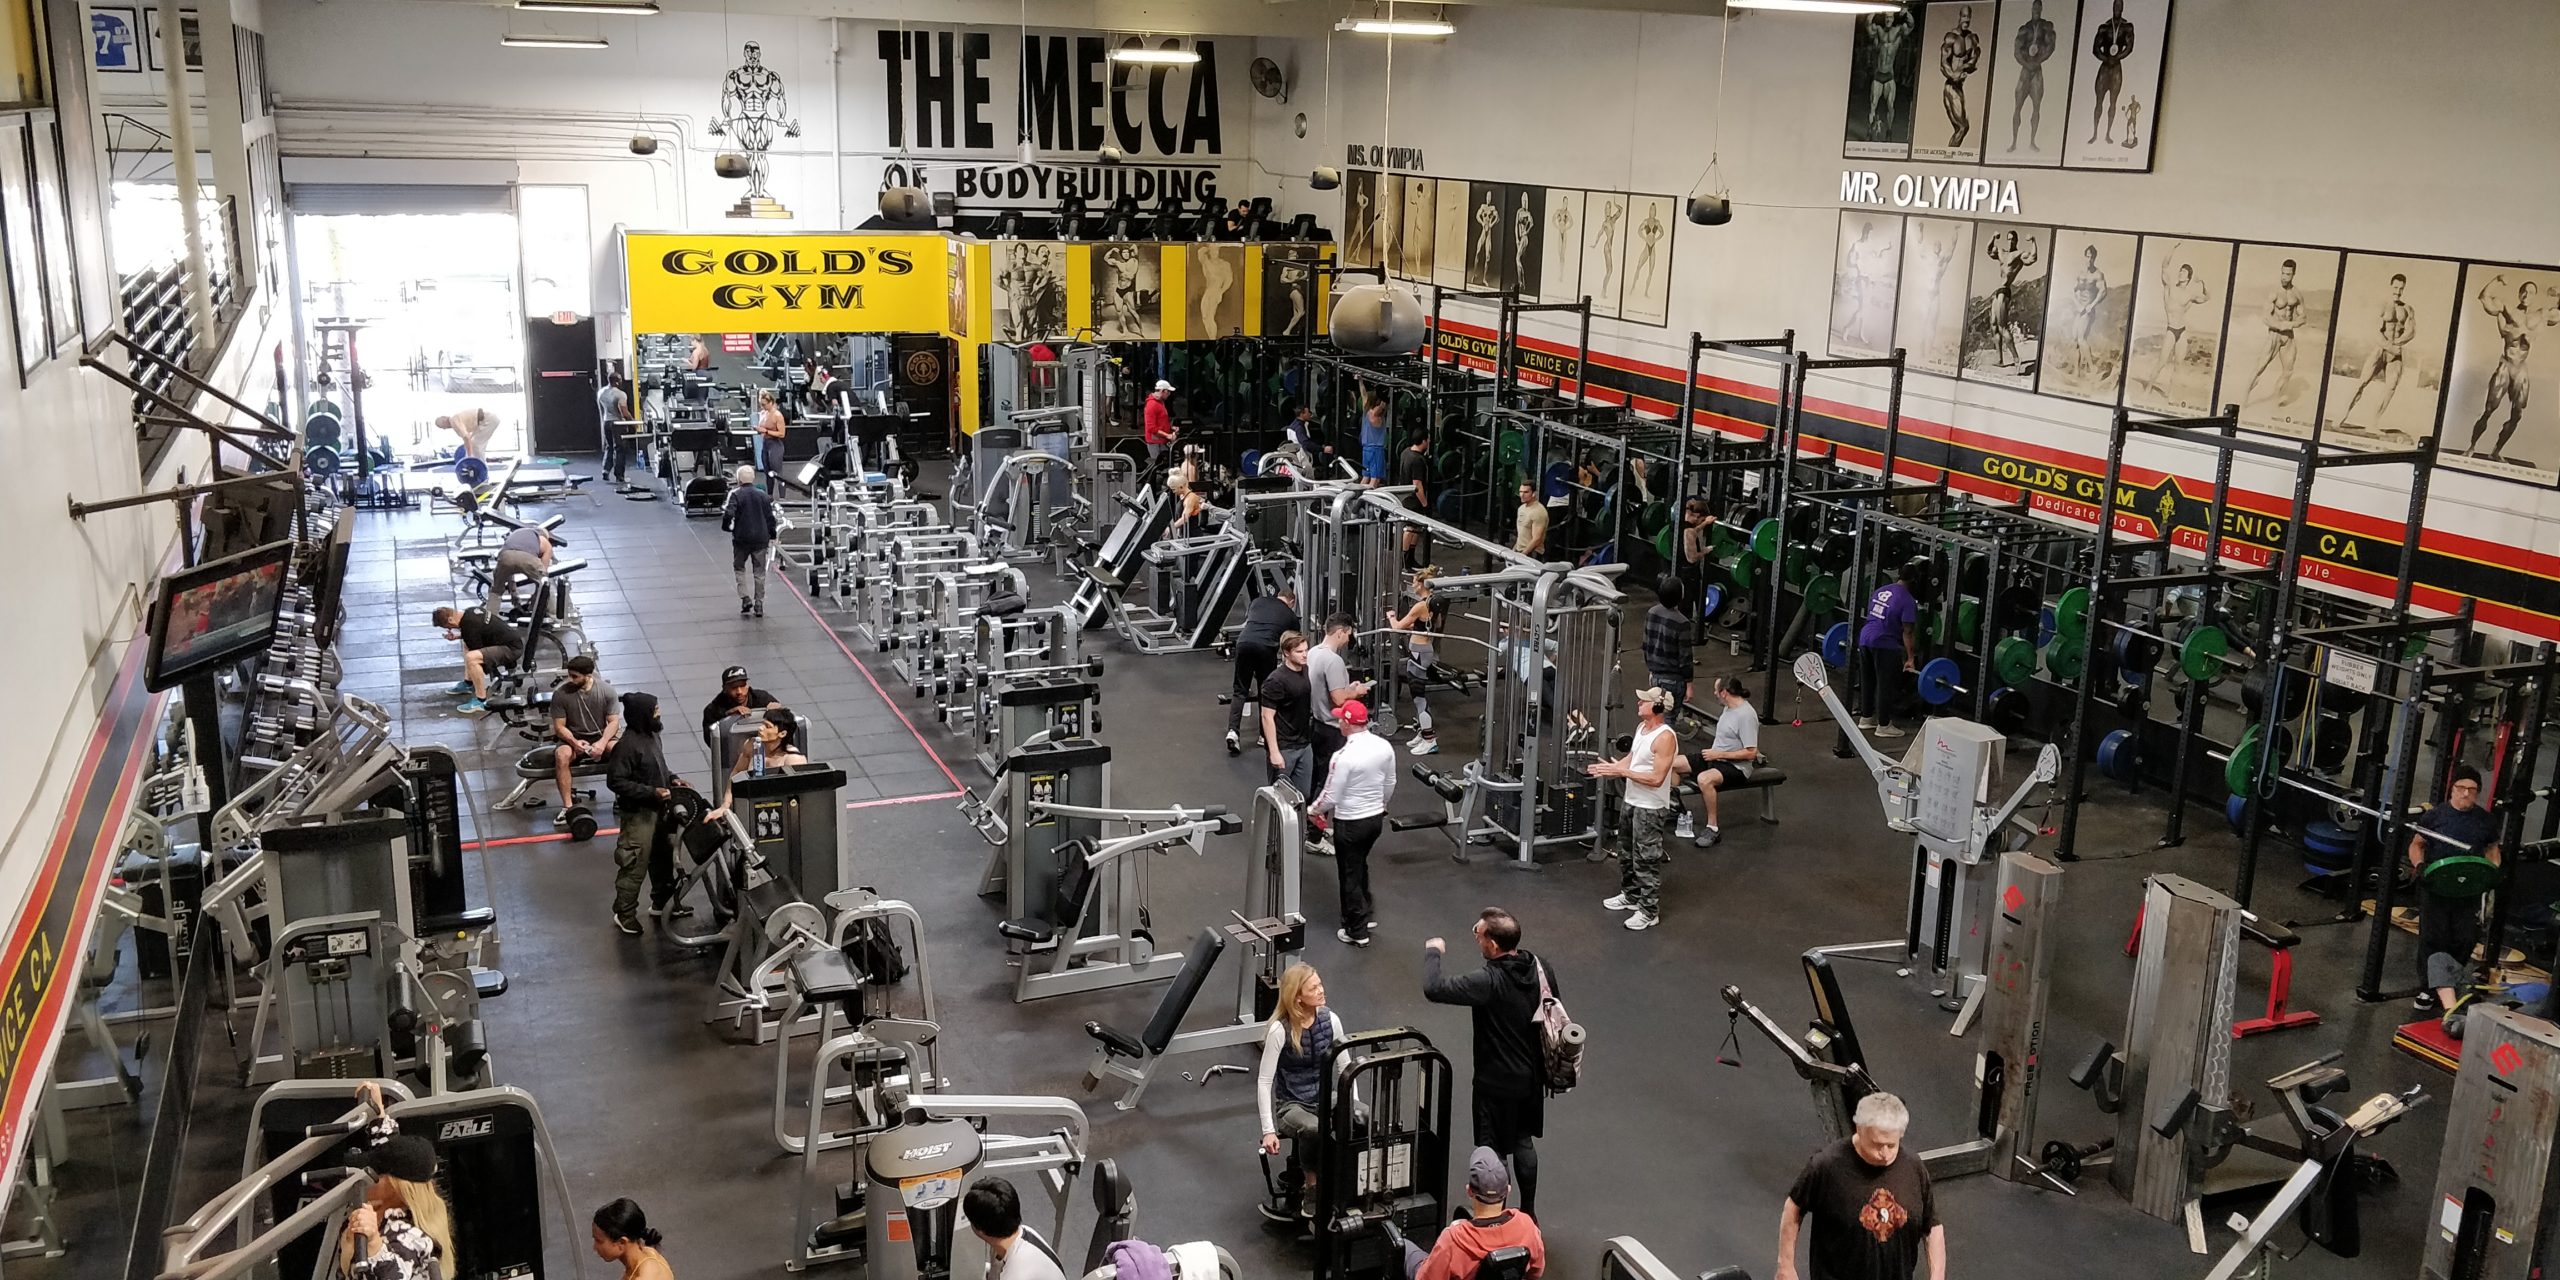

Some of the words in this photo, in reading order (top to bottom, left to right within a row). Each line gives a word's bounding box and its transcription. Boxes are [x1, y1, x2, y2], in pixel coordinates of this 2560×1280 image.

[878, 30, 993, 149] THE
[1017, 36, 1222, 155] MECCA
[1347, 144, 1367, 166] MS.
[1370, 145, 1424, 171] OLYMPIA
[956, 167, 1217, 203] BODYBUILDING
[1840, 171, 1886, 204] MR.
[1893, 174, 2021, 214] OLYMPIA
[661, 247, 914, 275] GOLD'S
[712, 284, 866, 309] GYM
[1472, 340, 1497, 357] GYM
[1523, 351, 1561, 373] VENICE
[1518, 369, 1533, 381] very
[1983, 457, 2068, 491] GOLD'S
[2320, 534, 2359, 561] CA
[30, 931, 52, 992] CA
[440, 1121, 491, 1140] EAGLE
[903, 1141, 953, 1160] HOIST
